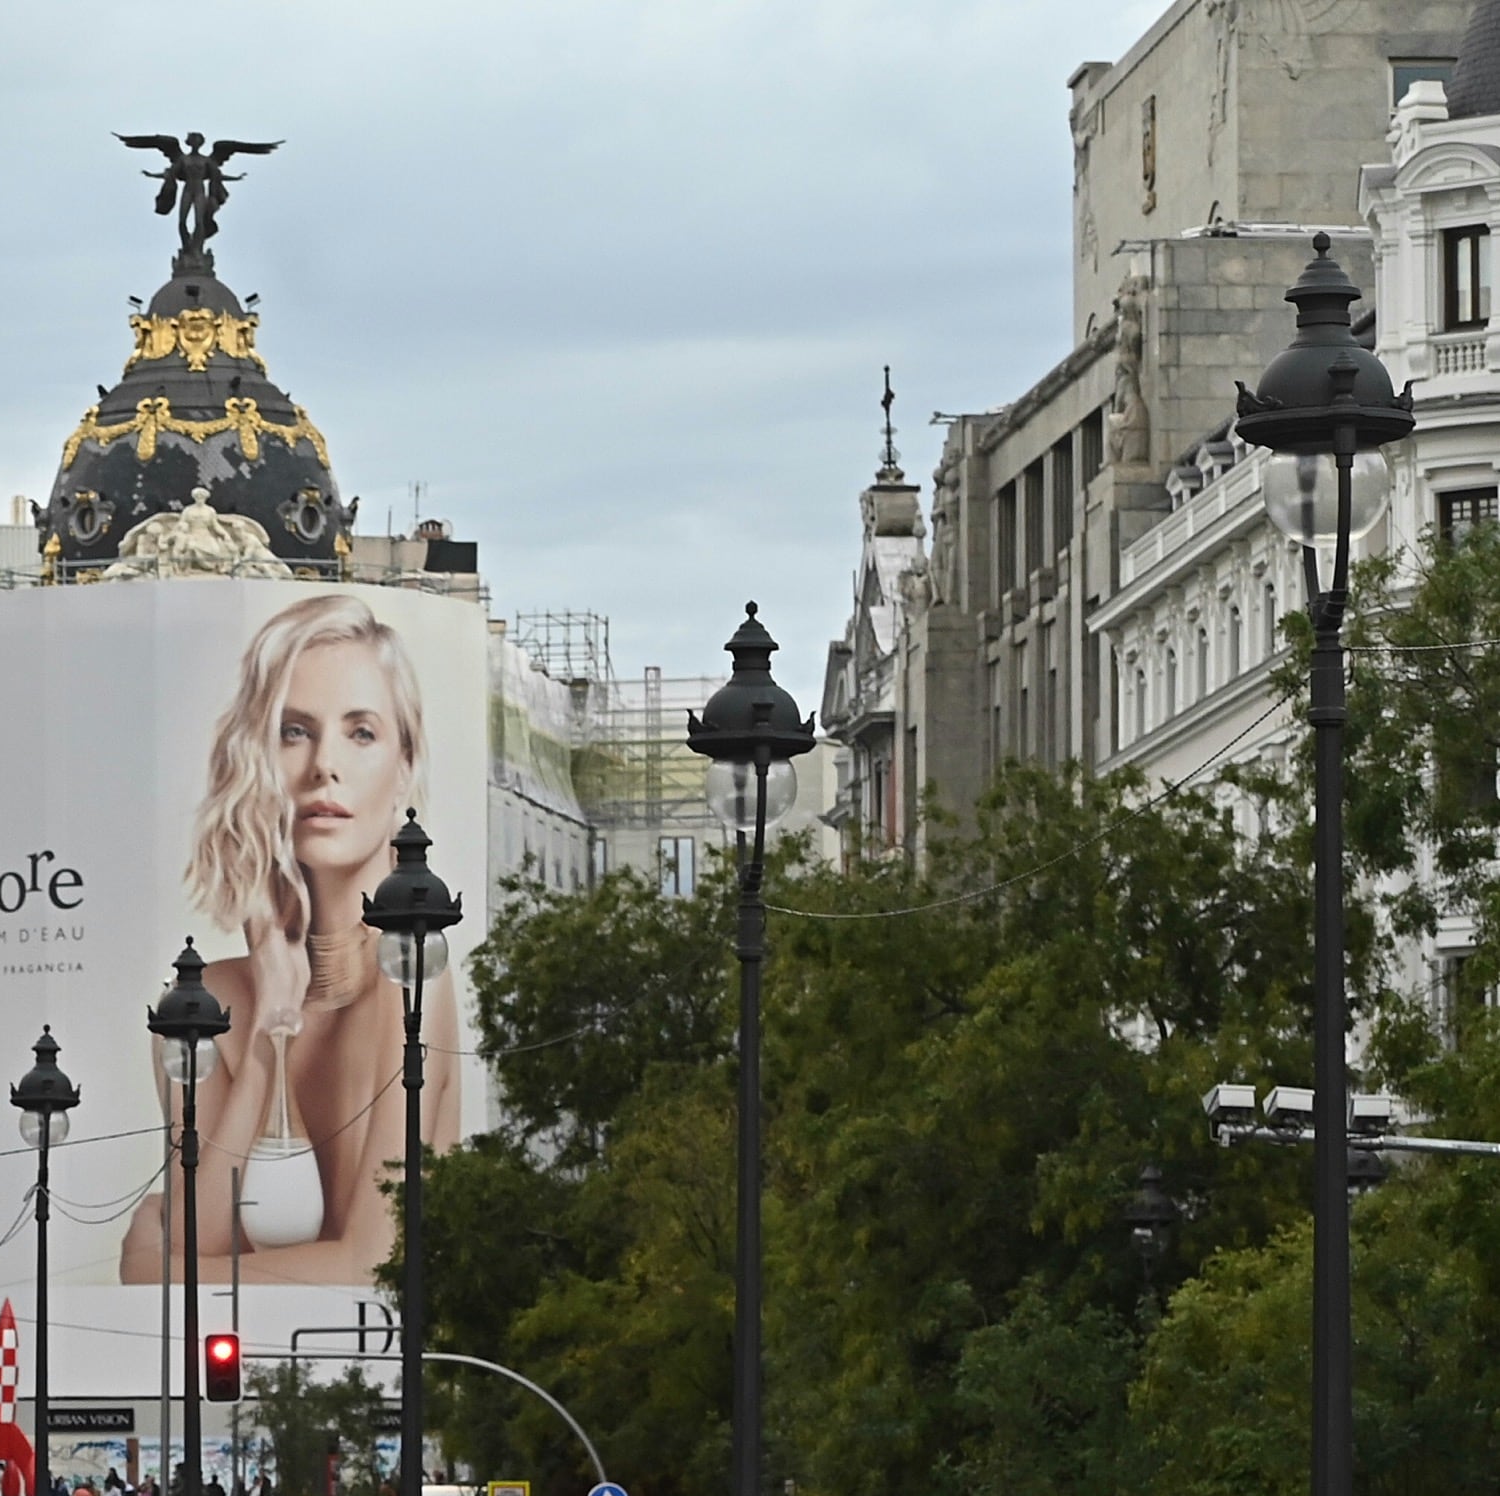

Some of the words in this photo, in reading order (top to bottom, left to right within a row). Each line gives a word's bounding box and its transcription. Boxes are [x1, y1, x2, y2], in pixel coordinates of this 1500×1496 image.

[19, 926, 85, 944] D'EAU
[3, 962, 84, 976] FRAGANCIA
[91, 1409, 130, 1424] VISION
